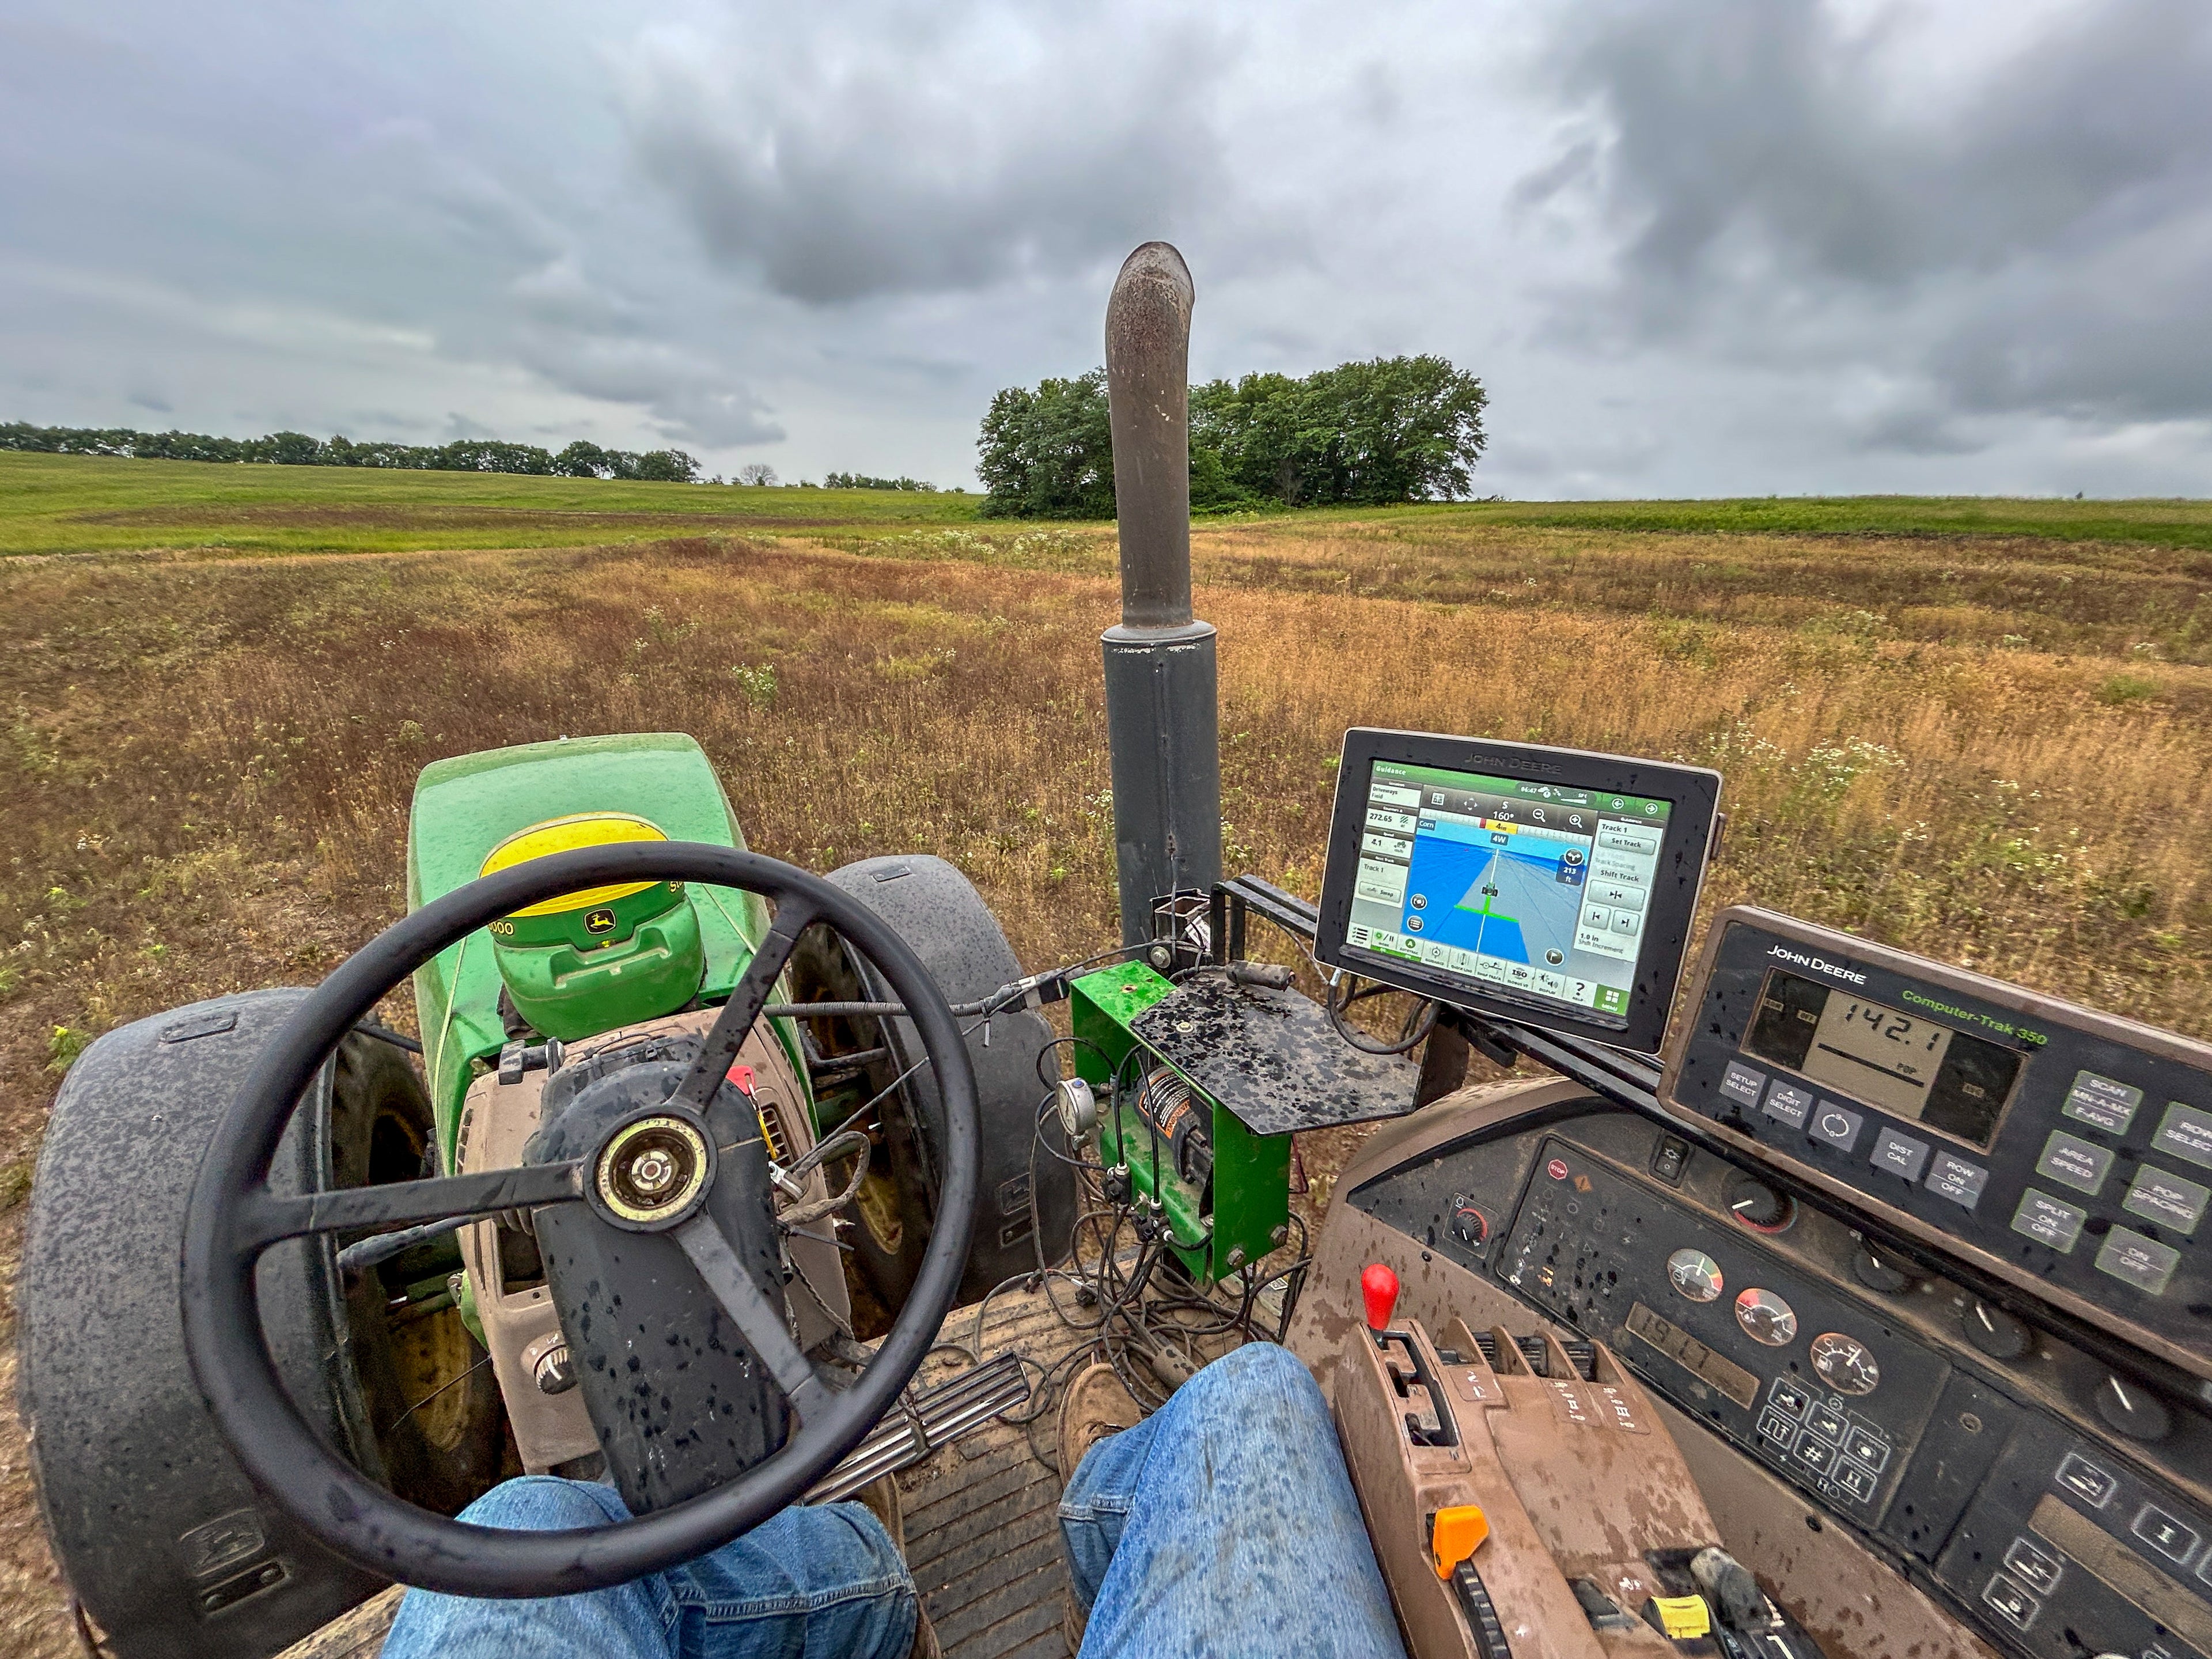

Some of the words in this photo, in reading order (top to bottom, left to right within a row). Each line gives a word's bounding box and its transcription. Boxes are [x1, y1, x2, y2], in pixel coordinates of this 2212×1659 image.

[1464, 753, 1507, 767] JOHN
[1510, 757, 1563, 774] DEERE
[1376, 766, 1407, 775] Guidance
[1373, 787, 1398, 795] Driveways
[1502, 801, 1509, 809] S
[1369, 813, 1392, 823] 272.65
[1493, 810, 1514, 821] 160°
[1419, 820, 1434, 828] Corn
[1602, 824, 1622, 832] Track
[1371, 838, 1381, 846] 4.1
[1493, 835, 1506, 843] 4W
[1624, 840, 1642, 849] Track
[1364, 864, 1380, 872] Track
[1601, 870, 1618, 878] Shift
[1620, 873, 1639, 882] Track
[1380, 889, 1394, 897] Swap
[1592, 942, 1623, 954] Increment
[1767, 945, 1810, 967] JOHN
[1810, 957, 1868, 985] DEERE
[1512, 969, 1528, 978] ISO
[1902, 990, 2014, 1035] Computer-Trak
[2016, 1028, 2048, 1046] 350
[1845, 1003, 1940, 1051] 142.1
[1731, 1072, 1758, 1086] SETUP
[1726, 1080, 1756, 1096] SELECT
[2089, 1079, 2127, 1097] SCAN
[1777, 1092, 1801, 1107] DIGIT
[1770, 1099, 1803, 1118] SELECT
[2166, 1129, 2212, 1152] SELEC
[1888, 1142, 1914, 1157] DIST
[1887, 1152, 1907, 1165] CAL
[1550, 1164, 1565, 1174] STOP
[1946, 1160, 1975, 1177] ROW
[2050, 1156, 2093, 1178] SPEED
[1947, 1173, 1966, 1185] ON
[1941, 1182, 1964, 1195] OFF
[2035, 1200, 2071, 1219] SPLIT
[2037, 1214, 2058, 1228] ON
[2031, 1223, 2057, 1237] OFF
[2128, 1247, 2149, 1262] ON
[2119, 1256, 2148, 1271] OFF
